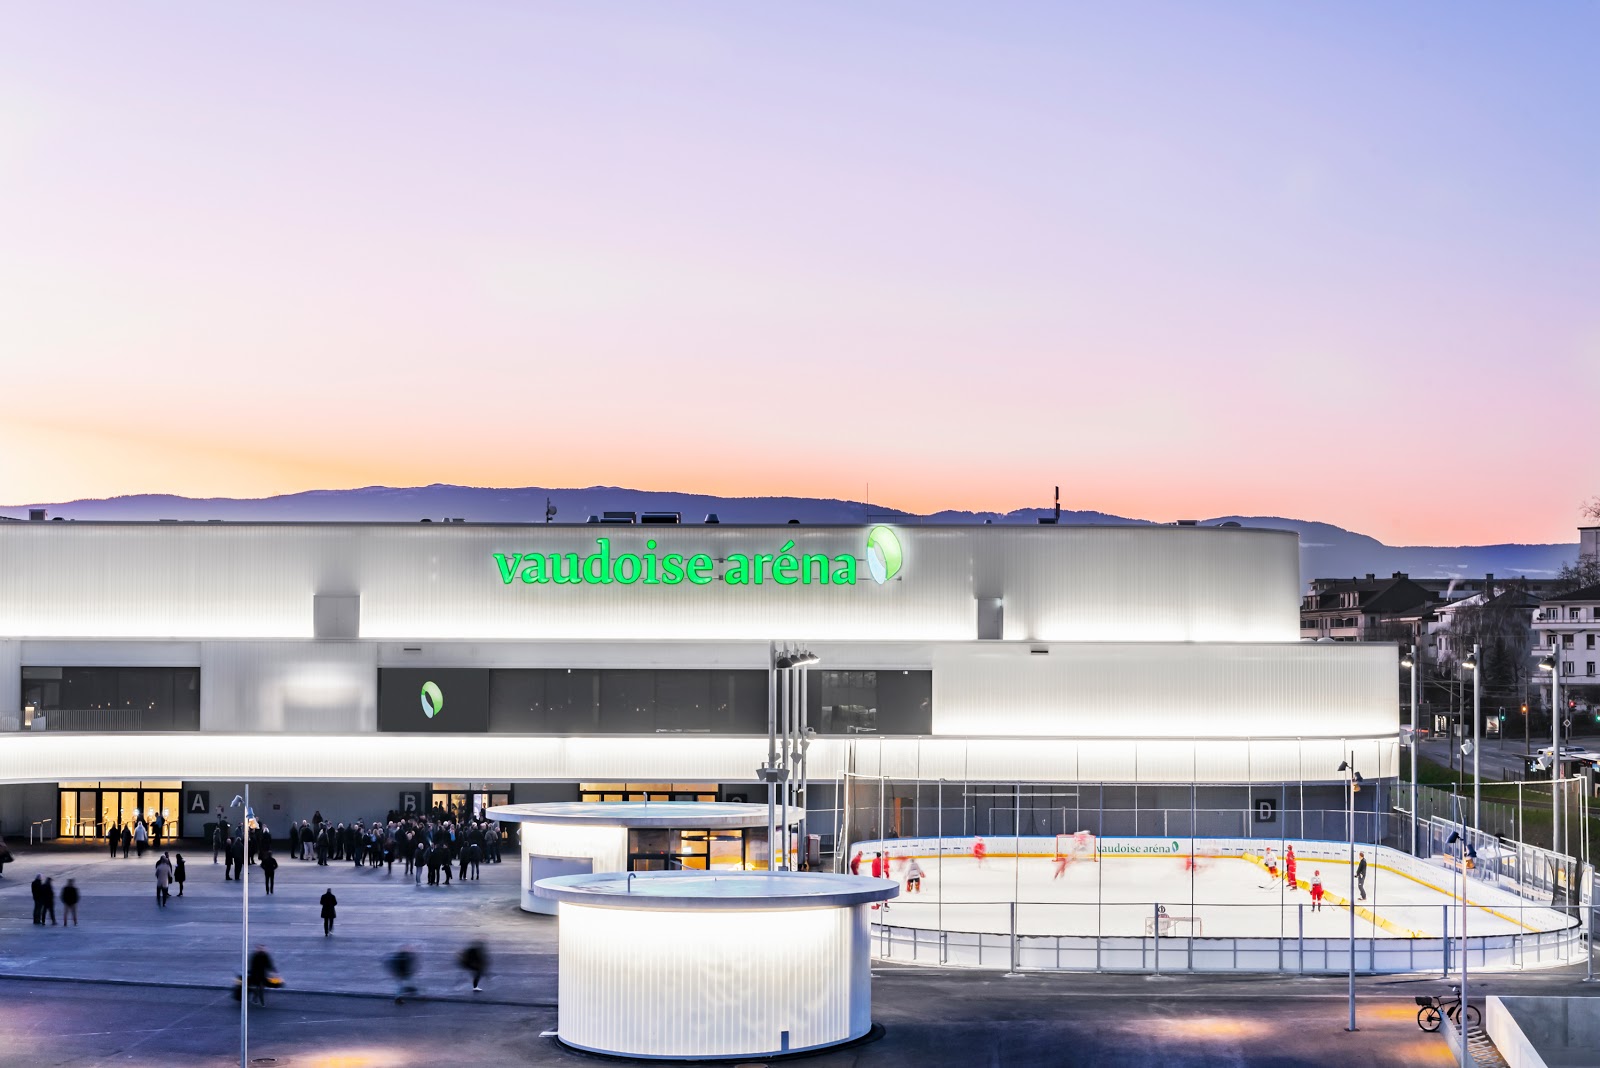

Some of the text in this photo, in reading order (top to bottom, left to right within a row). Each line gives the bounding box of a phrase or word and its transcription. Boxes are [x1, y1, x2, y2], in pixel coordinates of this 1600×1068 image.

[492, 537, 857, 586] vaudoise aréna
[191, 793, 206, 811] A
[404, 794, 417, 812] B
[1259, 801, 1272, 820] D
[1143, 843, 1171, 853] aréna
